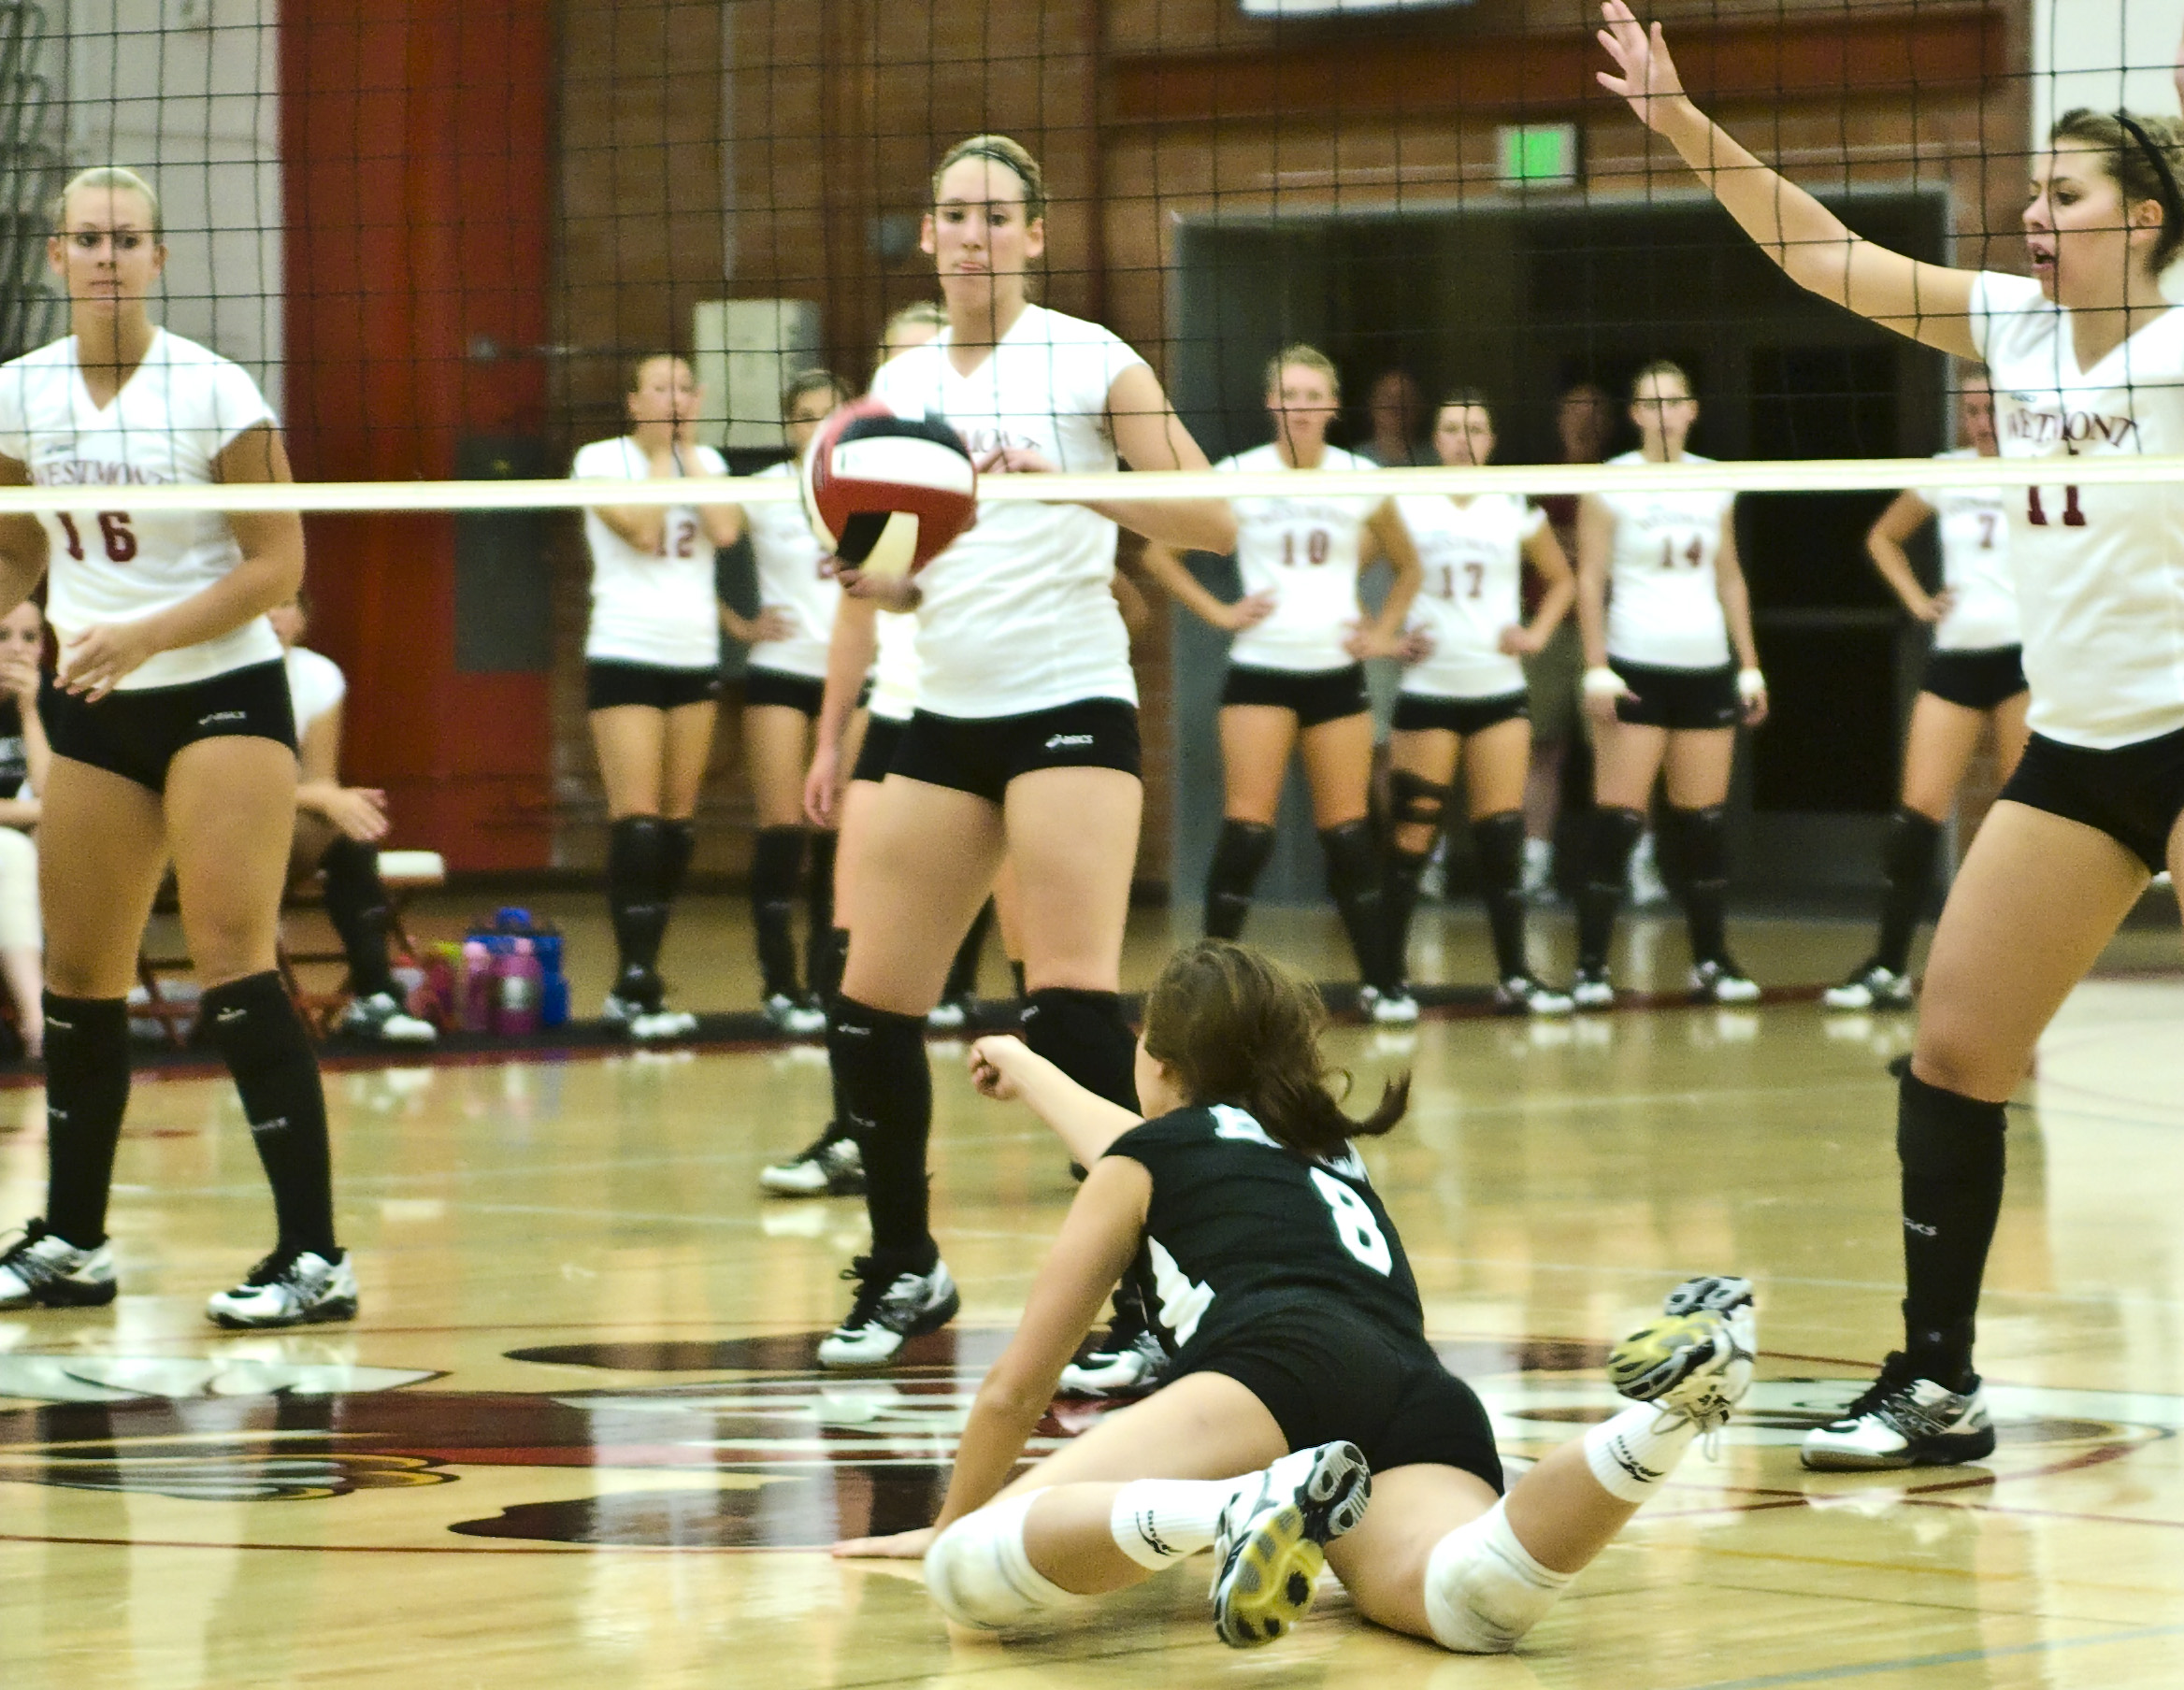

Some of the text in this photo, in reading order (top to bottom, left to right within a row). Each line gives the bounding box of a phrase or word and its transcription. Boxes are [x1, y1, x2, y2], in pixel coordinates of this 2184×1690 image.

[55, 511, 137, 563] 16
[1282, 528, 1330, 566] 10
[1977, 514, 1995, 549] 7
[1661, 535, 1702, 569] 14
[1441, 562, 1485, 598] 17
[1310, 1167, 1393, 1277] 8
